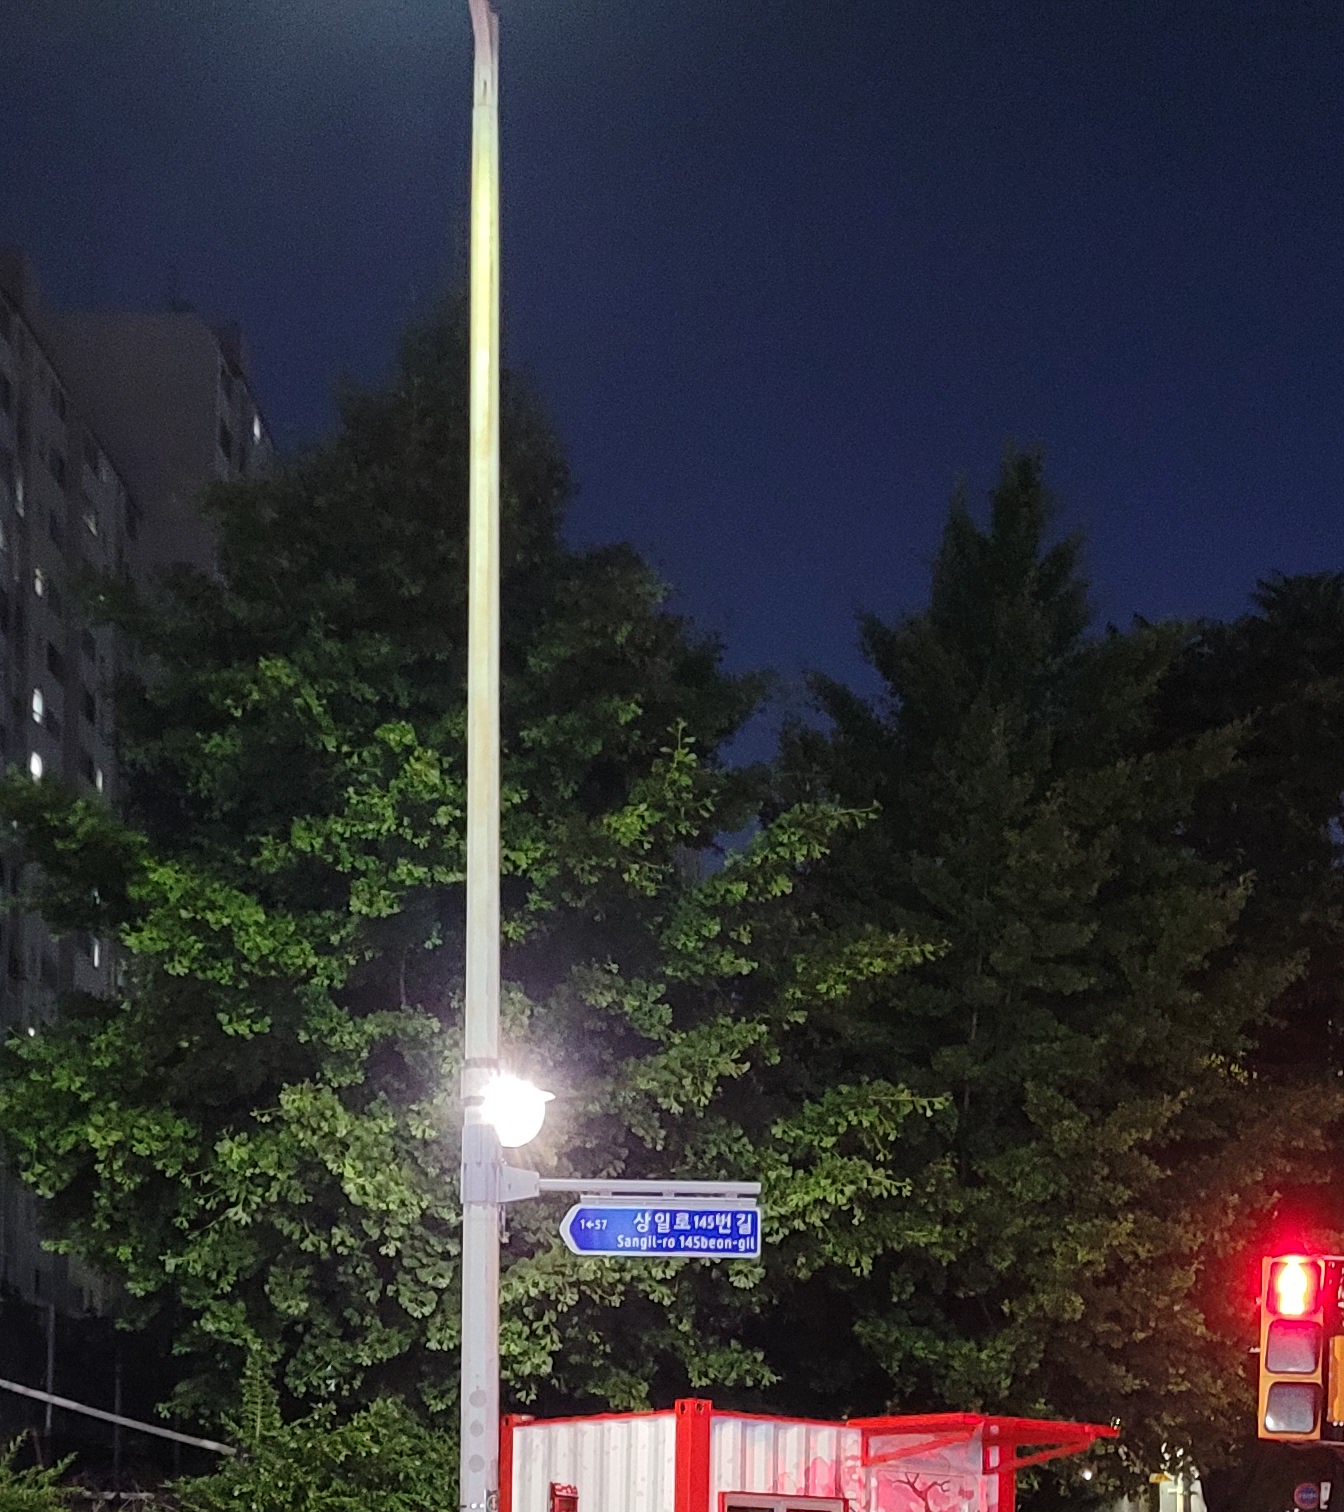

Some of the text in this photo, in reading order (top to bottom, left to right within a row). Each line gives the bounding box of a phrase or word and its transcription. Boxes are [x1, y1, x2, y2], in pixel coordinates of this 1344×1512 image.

[633, 1211, 753, 1235] 상일로145번길
[617, 1234, 755, 1251] Sangil-ro 145beon-gil
